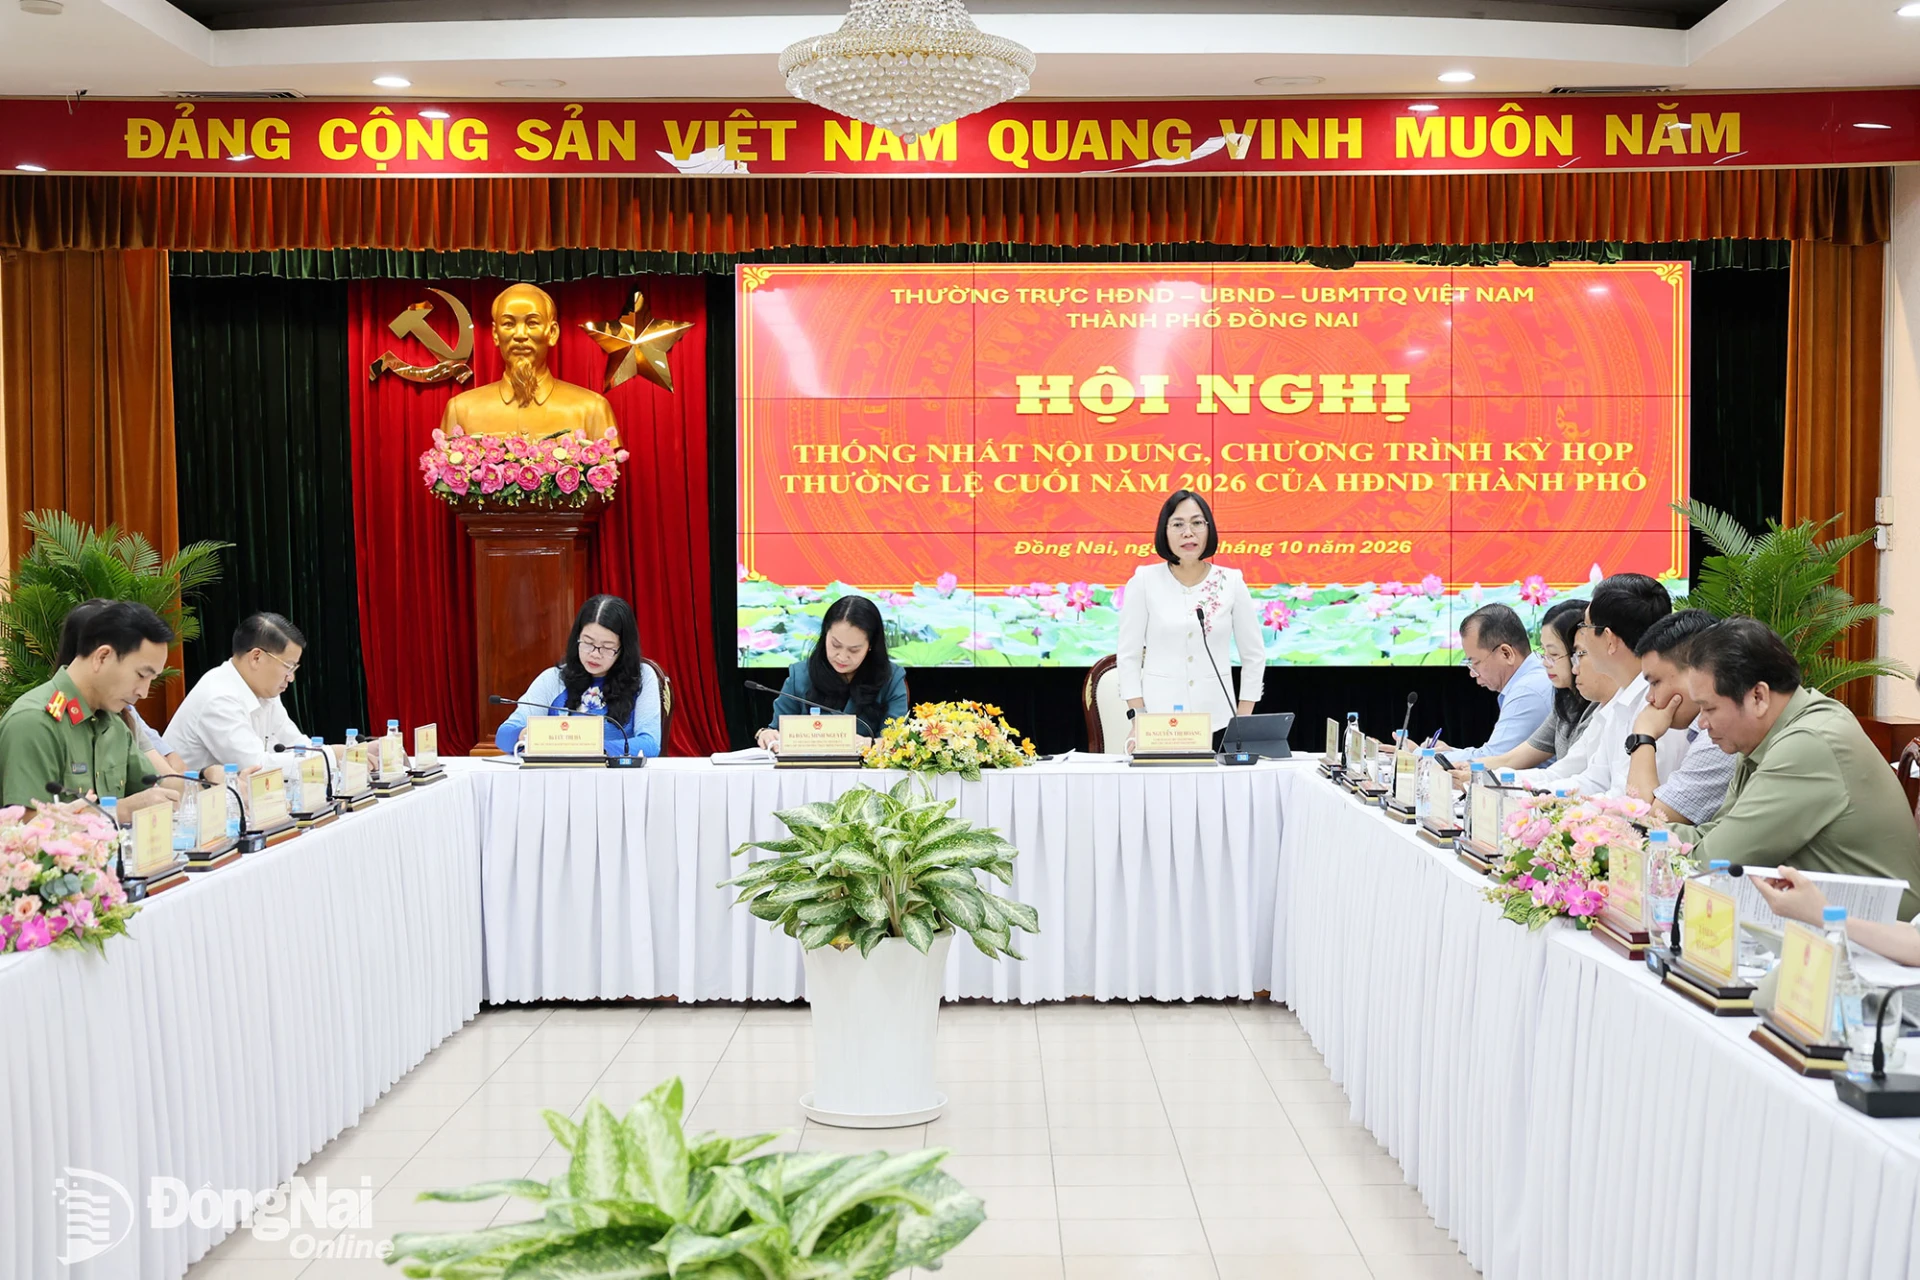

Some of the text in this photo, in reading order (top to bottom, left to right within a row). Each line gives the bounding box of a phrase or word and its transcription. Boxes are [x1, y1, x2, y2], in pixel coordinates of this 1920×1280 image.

[124, 103, 291, 160] ĐẢNG
[318, 106, 489, 171] CỘNG
[514, 104, 636, 161] SẢN
[824, 119, 958, 162] NAM
[987, 119, 1192, 169] QUANG
[1219, 117, 1363, 160] VINH
[1395, 102, 1573, 159] MUÔN
[1605, 102, 1740, 156] NĂM
[890, 285, 1010, 304] THƯỜNG
[1015, 286, 1089, 306] TRỰC
[1096, 287, 1174, 304] HĐND
[1201, 287, 1276, 303] UBND
[1301, 286, 1408, 306] UBMTTQ
[1413, 283, 1470, 306] VIỆT
[1476, 286, 1534, 303] NAM
[1066, 306, 1358, 329] THÀNH PHỐ ĐỒNG NAI
[1015, 365, 1411, 423] HỘI NGHỊ
[792, 437, 1635, 468] THỐNG NHẤT NỘI DUNG, CHƯƠNG TRÌNH KỲ HỌP
[780, 467, 1647, 498] THƯỜNG LỆ CUỐI NĂM 2026 CỦA HĐND THÀNH PHỐ
[1014, 540, 1073, 558] Đồng
[1076, 540, 1119, 557] Nai,
[1279, 540, 1303, 554] 10
[1307, 540, 1356, 554] năm
[1360, 540, 1412, 554] 2026
